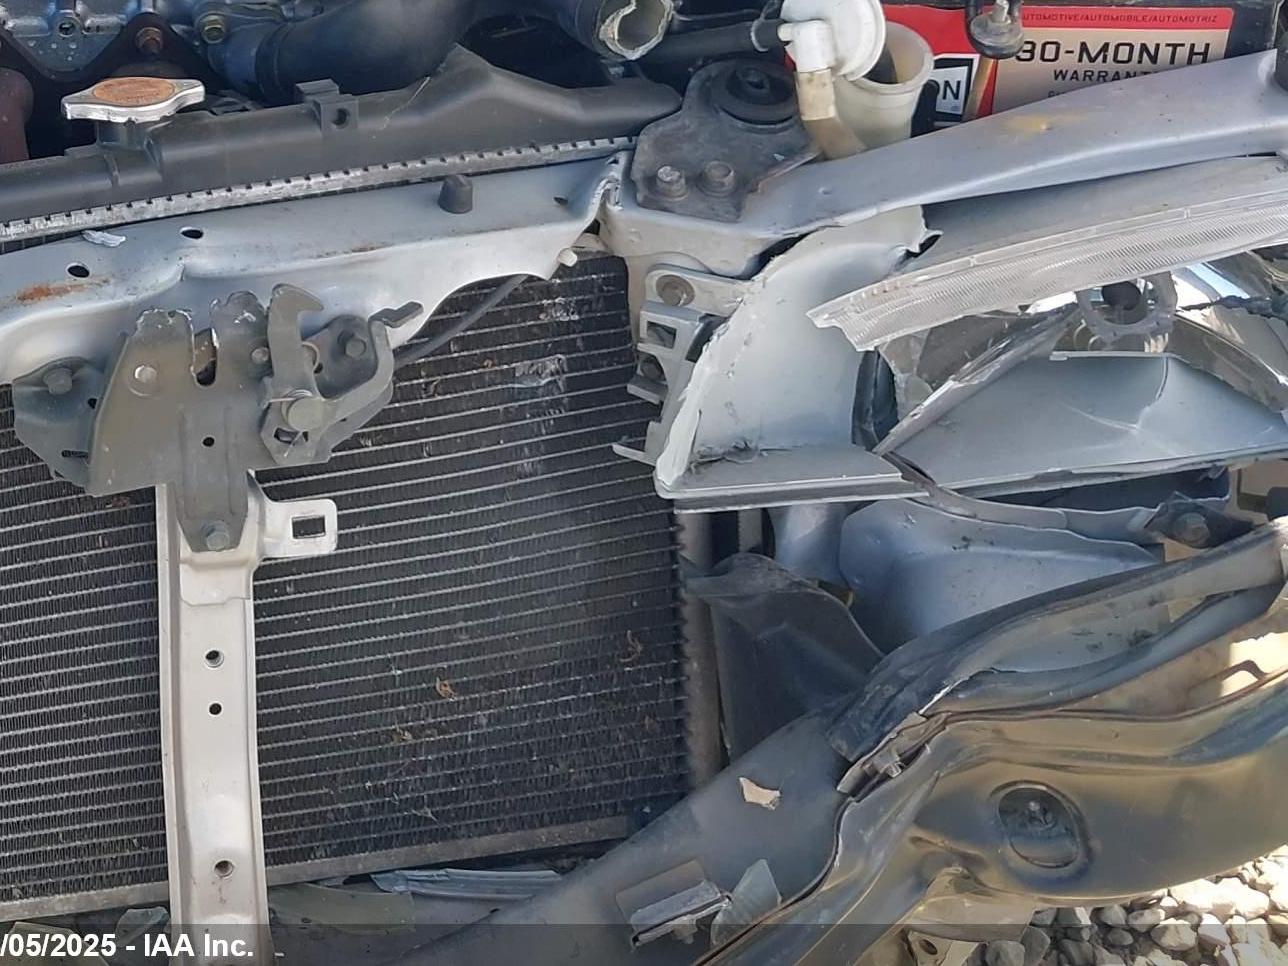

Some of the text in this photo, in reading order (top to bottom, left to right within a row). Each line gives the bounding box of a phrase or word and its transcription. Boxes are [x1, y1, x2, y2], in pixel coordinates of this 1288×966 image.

[1023, 13, 1218, 23] UTOMOTIVE/AUTOMOBILE/AUTOMOTRIZ
[1016, 41, 1211, 65] 30-MONTH
[1054, 69, 1159, 82] WARRAN
